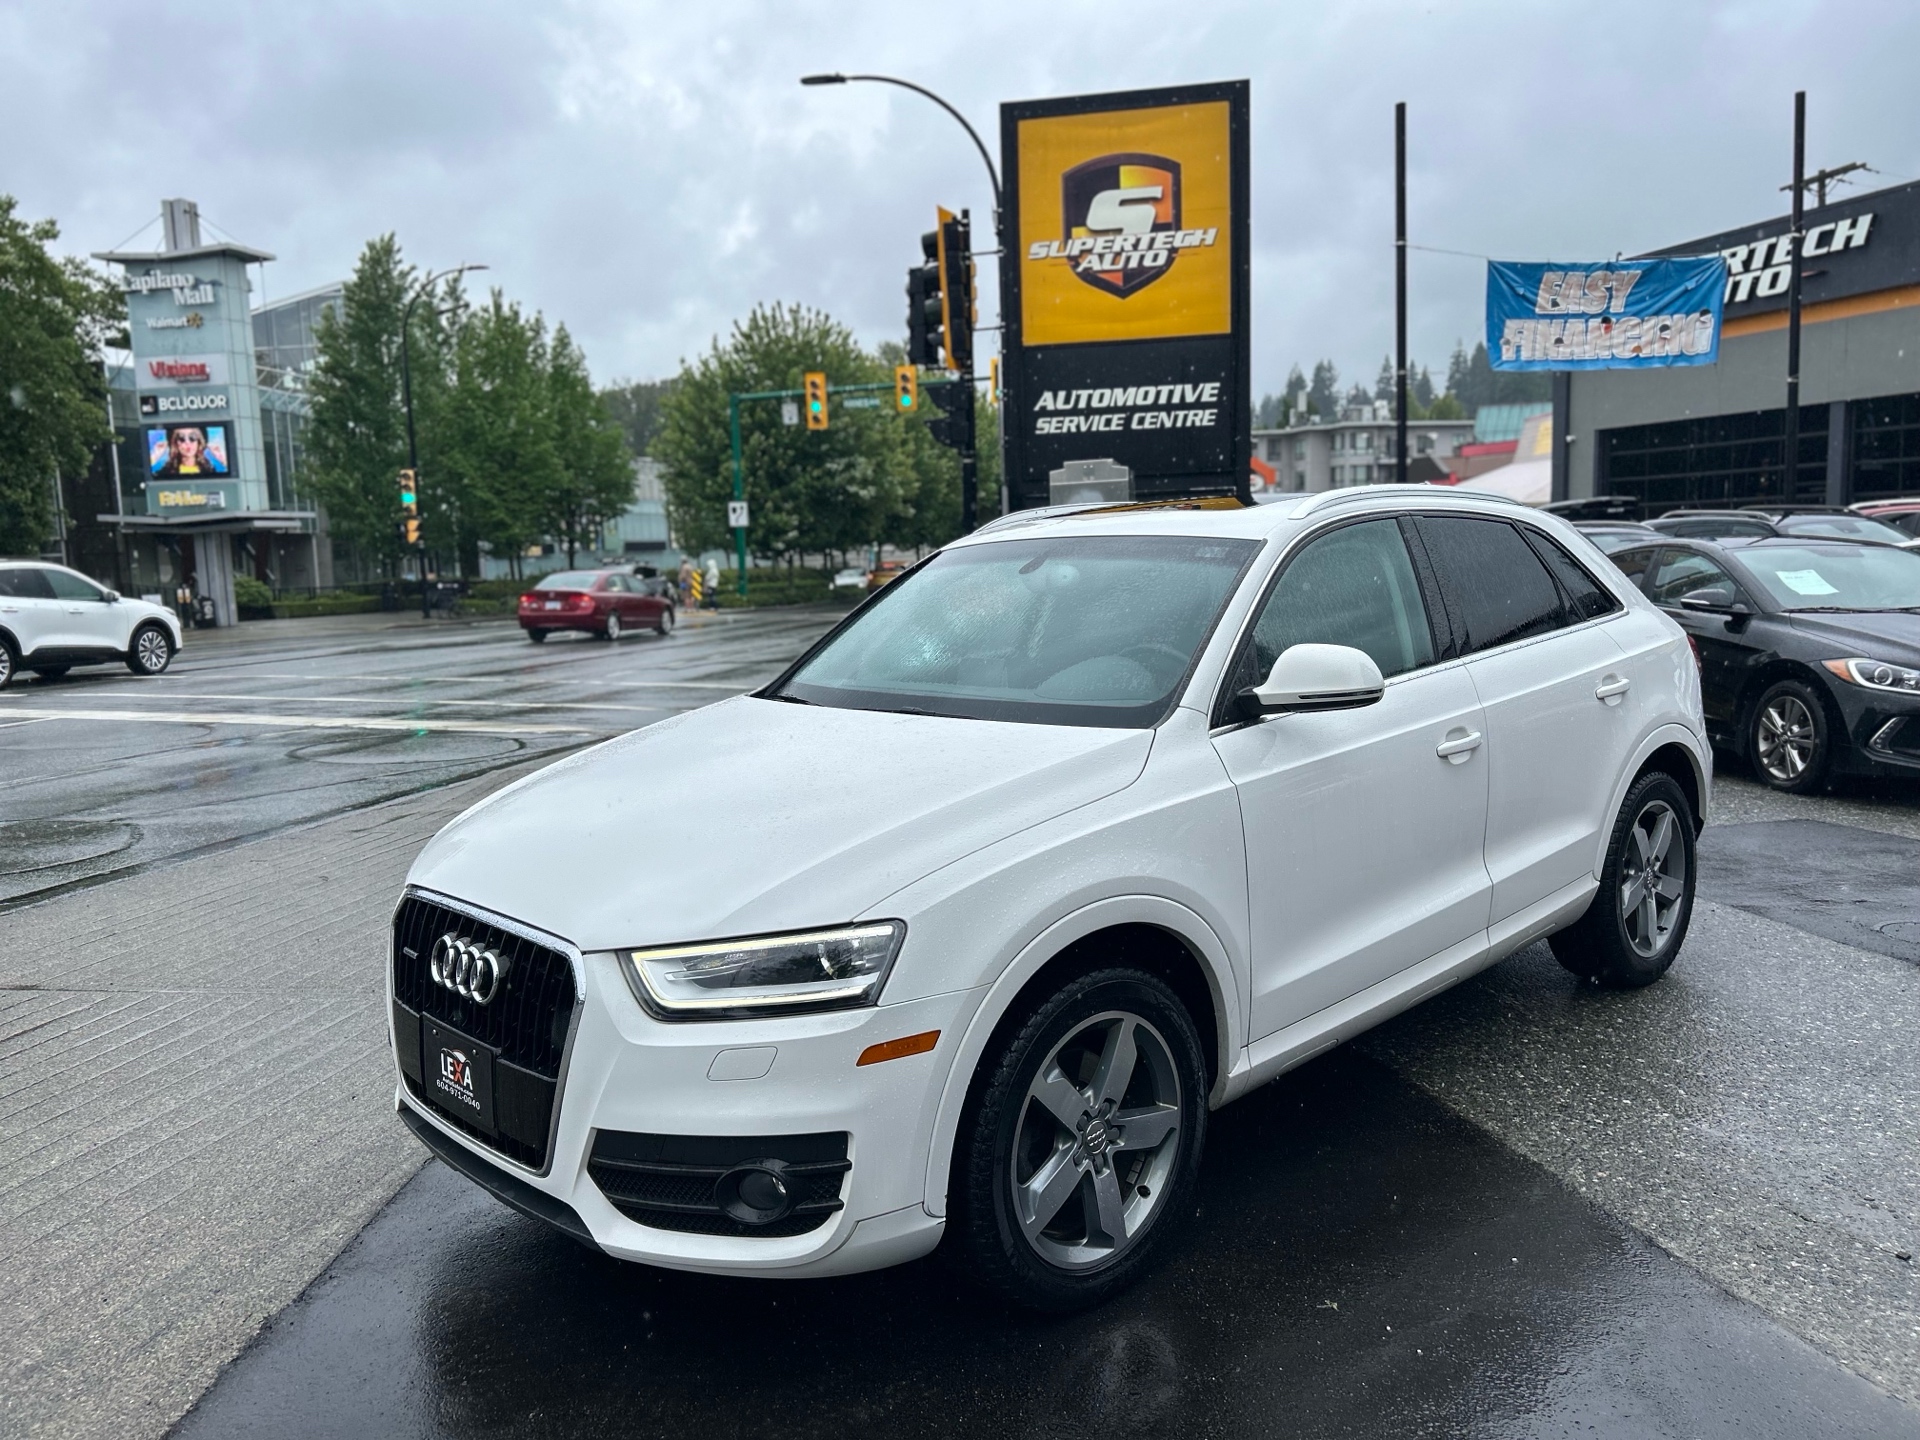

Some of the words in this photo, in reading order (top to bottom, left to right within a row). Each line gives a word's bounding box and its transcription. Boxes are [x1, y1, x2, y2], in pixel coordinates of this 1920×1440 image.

[1028, 228, 1218, 260] SUPERTECH
[1719, 213, 1874, 275] RTECH
[1076, 248, 1169, 274] AUTO
[172, 283, 214, 306] Mall
[1535, 270, 1642, 314] EASY
[1034, 382, 1221, 412] AUTOMOTIVE
[1034, 412, 1125, 435] SERVICE
[1130, 408, 1218, 431] CENTRE
[440, 1052, 473, 1091] LEXA
